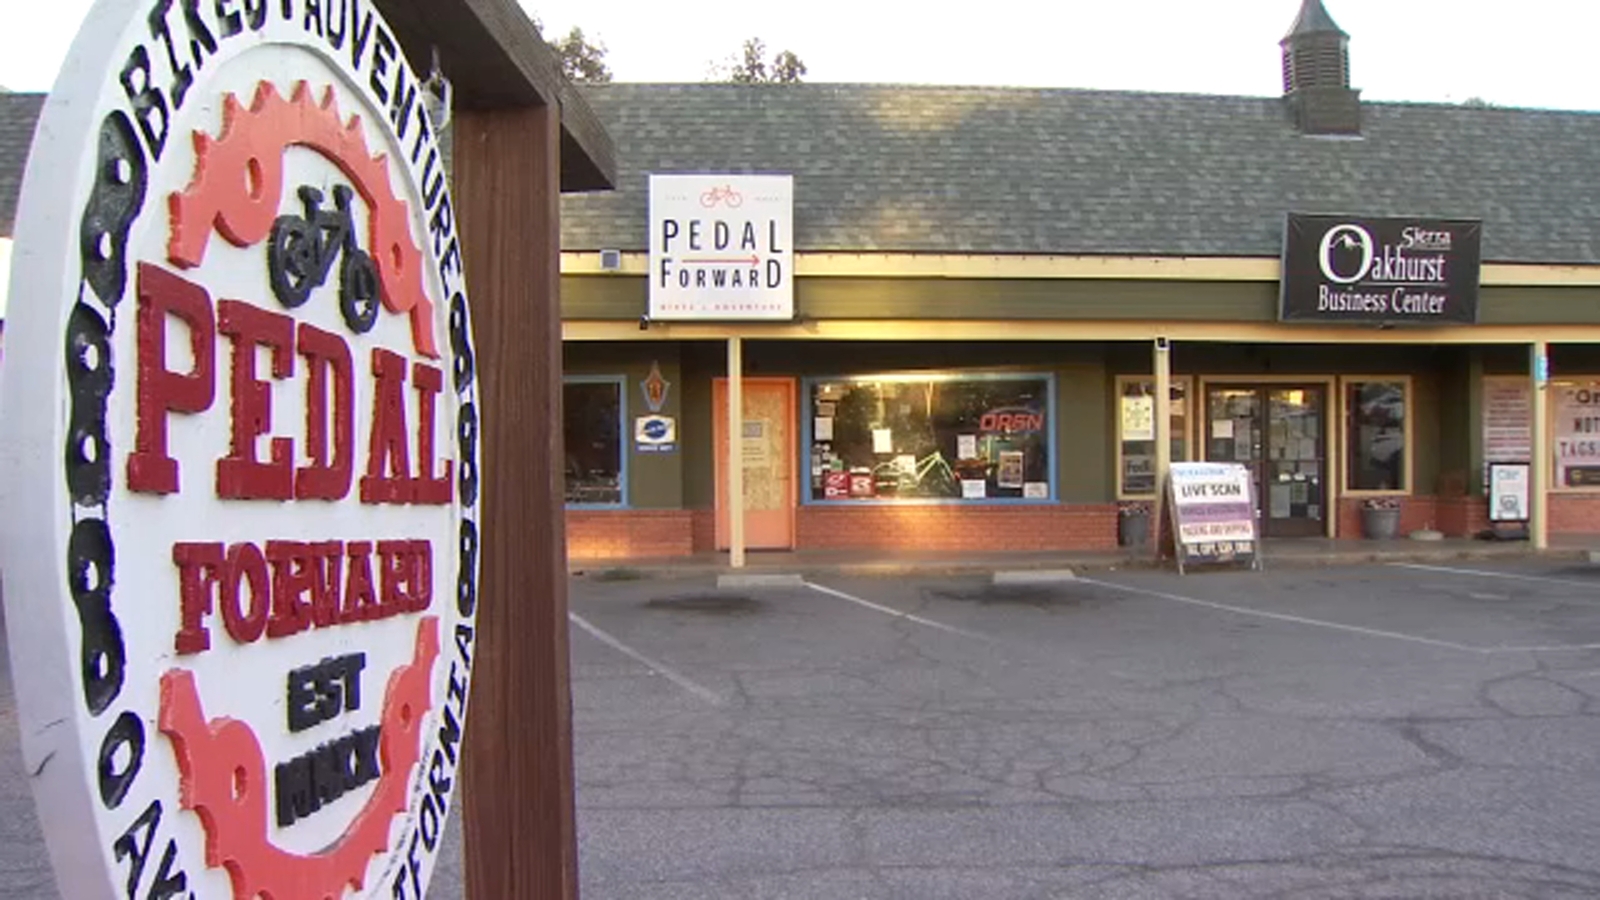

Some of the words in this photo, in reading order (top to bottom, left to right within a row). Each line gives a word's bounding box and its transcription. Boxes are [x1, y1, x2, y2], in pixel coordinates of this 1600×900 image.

[663, 218, 783, 253] PEDAL
[1400, 225, 1452, 249] Sierra
[1319, 223, 1446, 284] Oakhurst
[660, 257, 782, 289] FORWARD
[1317, 284, 1388, 313] Business
[1392, 286, 1446, 314] Center
[127, 260, 454, 506] PEDAL
[1182, 484, 1206, 498] LIVE
[1210, 484, 1241, 497] SCAN
[172, 539, 433, 655] FORWARD
[286, 651, 366, 733] EST
